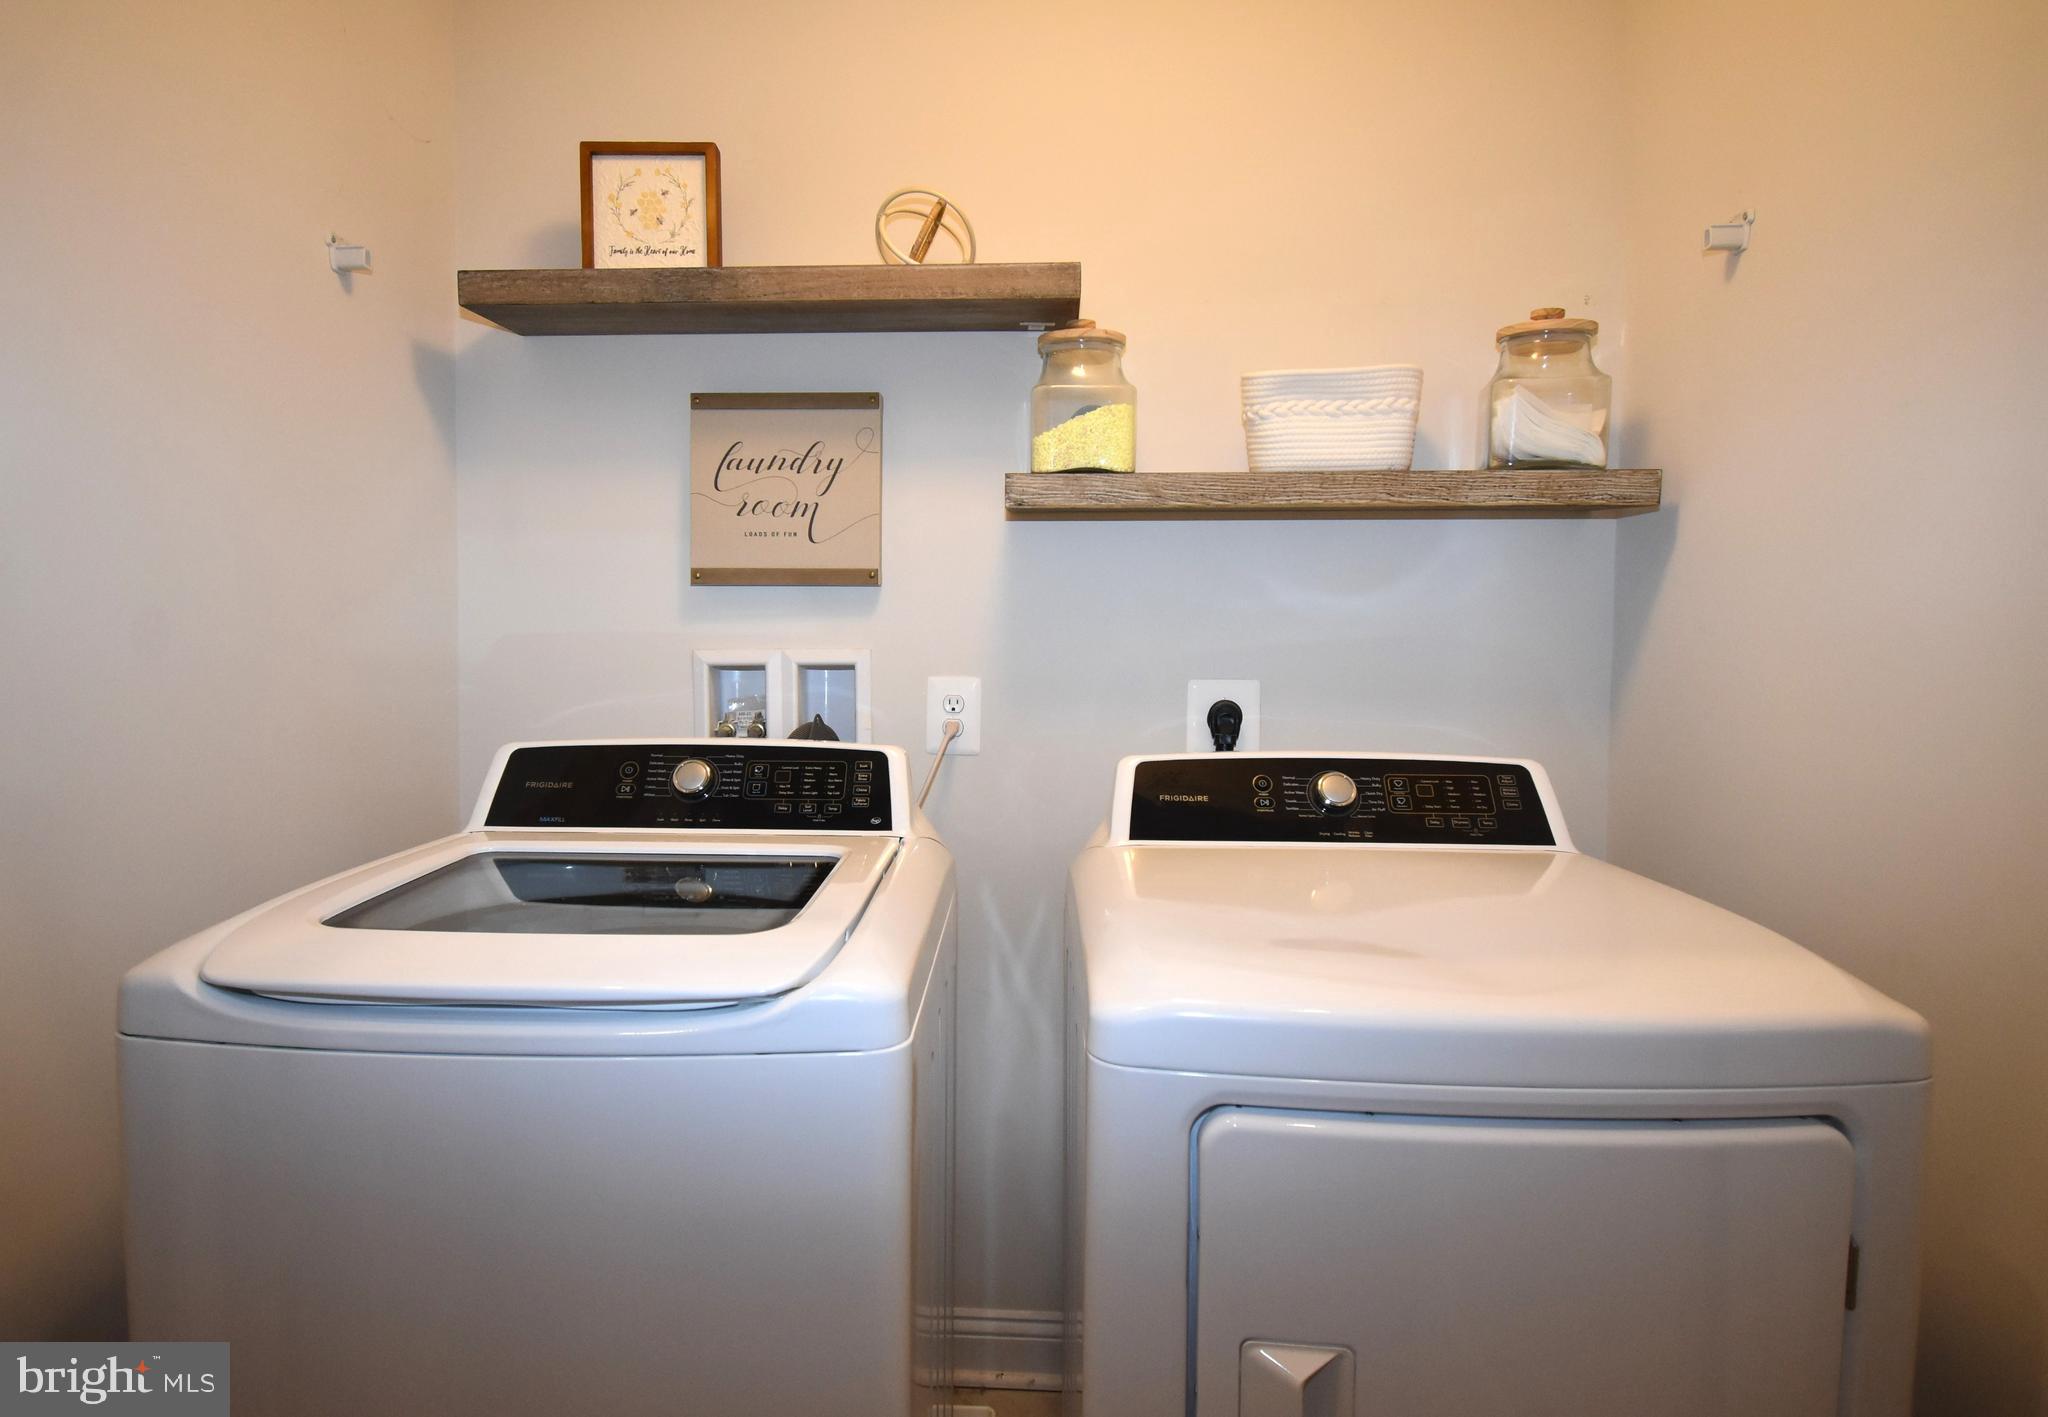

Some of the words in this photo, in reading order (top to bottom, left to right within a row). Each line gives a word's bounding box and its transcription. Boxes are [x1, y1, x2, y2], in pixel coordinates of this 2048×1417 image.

[609, 245, 628, 257] Family
[635, 246, 643, 255] the
[643, 245, 661, 256] Heart
[662, 247, 669, 257] of
[680, 245, 696, 256] Home
[713, 440, 845, 497] laundry
[735, 493, 820, 545] room
[525, 781, 575, 789] FRIGIDAIRE
